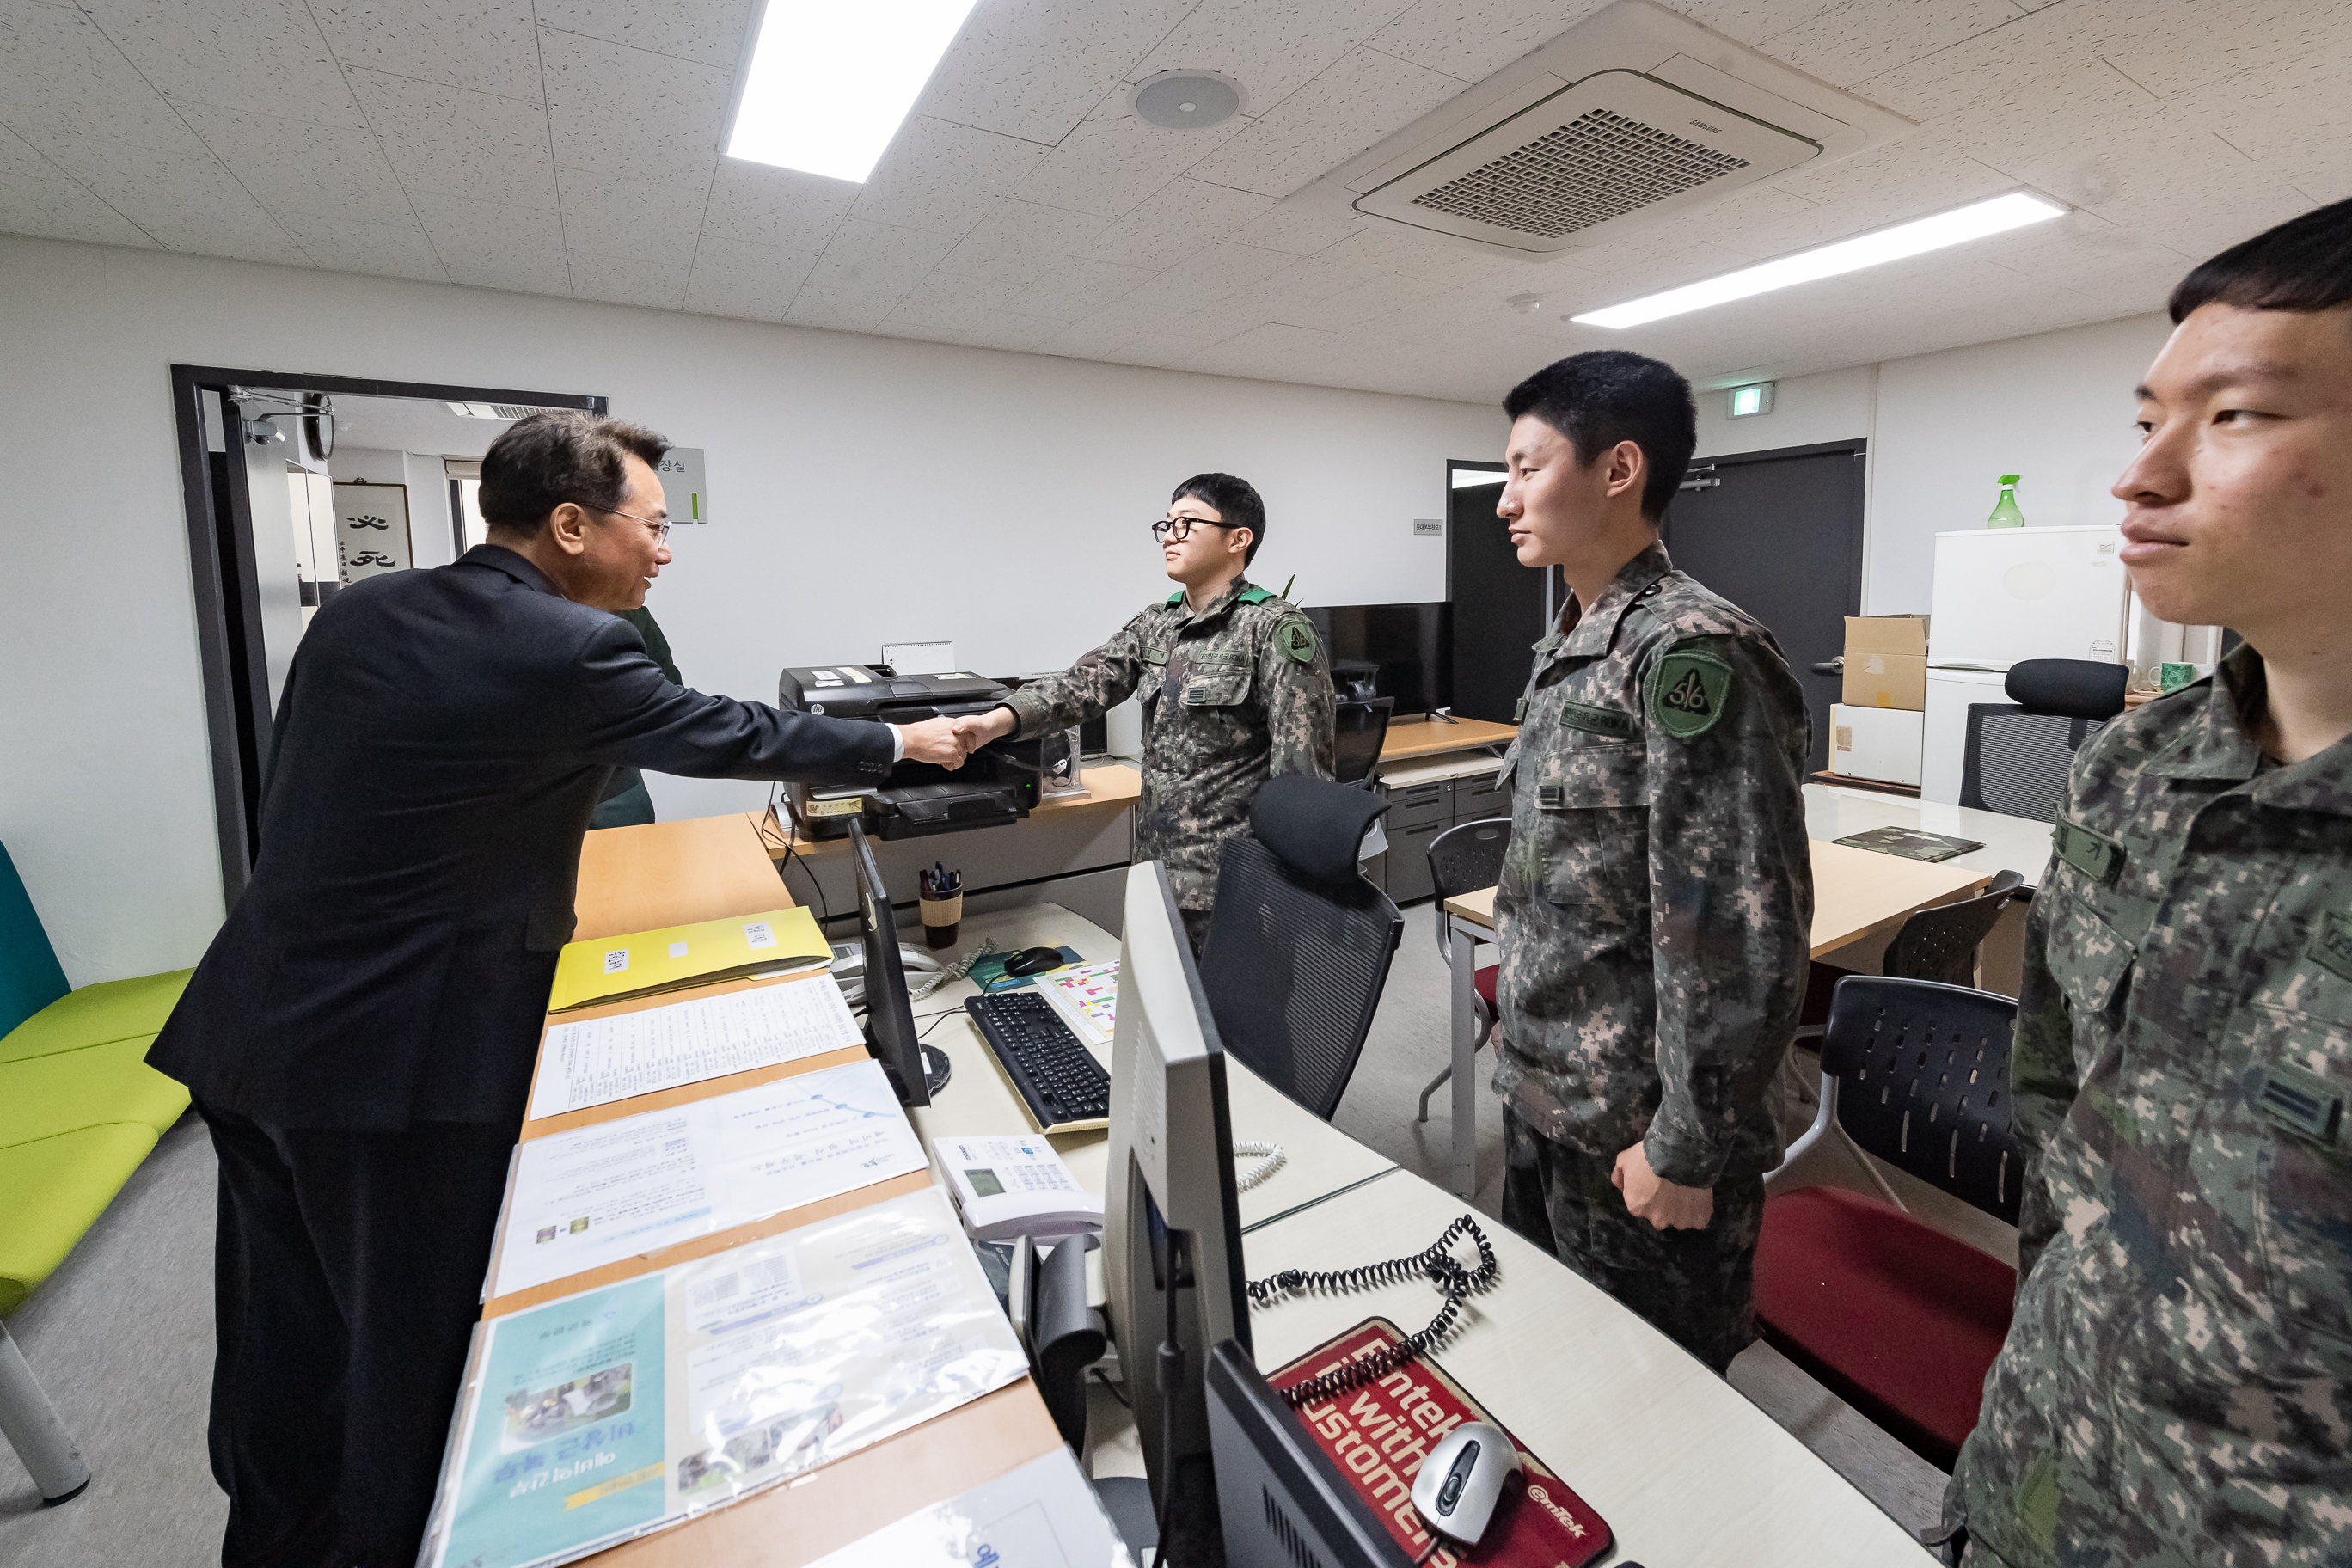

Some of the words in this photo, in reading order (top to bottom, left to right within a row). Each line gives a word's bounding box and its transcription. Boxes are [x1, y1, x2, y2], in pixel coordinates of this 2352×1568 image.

[1688, 119, 1723, 134] SAMSUNG
[655, 459, 686, 473] 장실
[1291, 632, 1307, 647] 56
[1229, 653, 1245, 663] ROKA
[1669, 680, 1705, 709] 56
[812, 703, 823, 715] hp
[1600, 715, 1629, 731] ROKA
[1348, 1390, 1429, 1478] with
